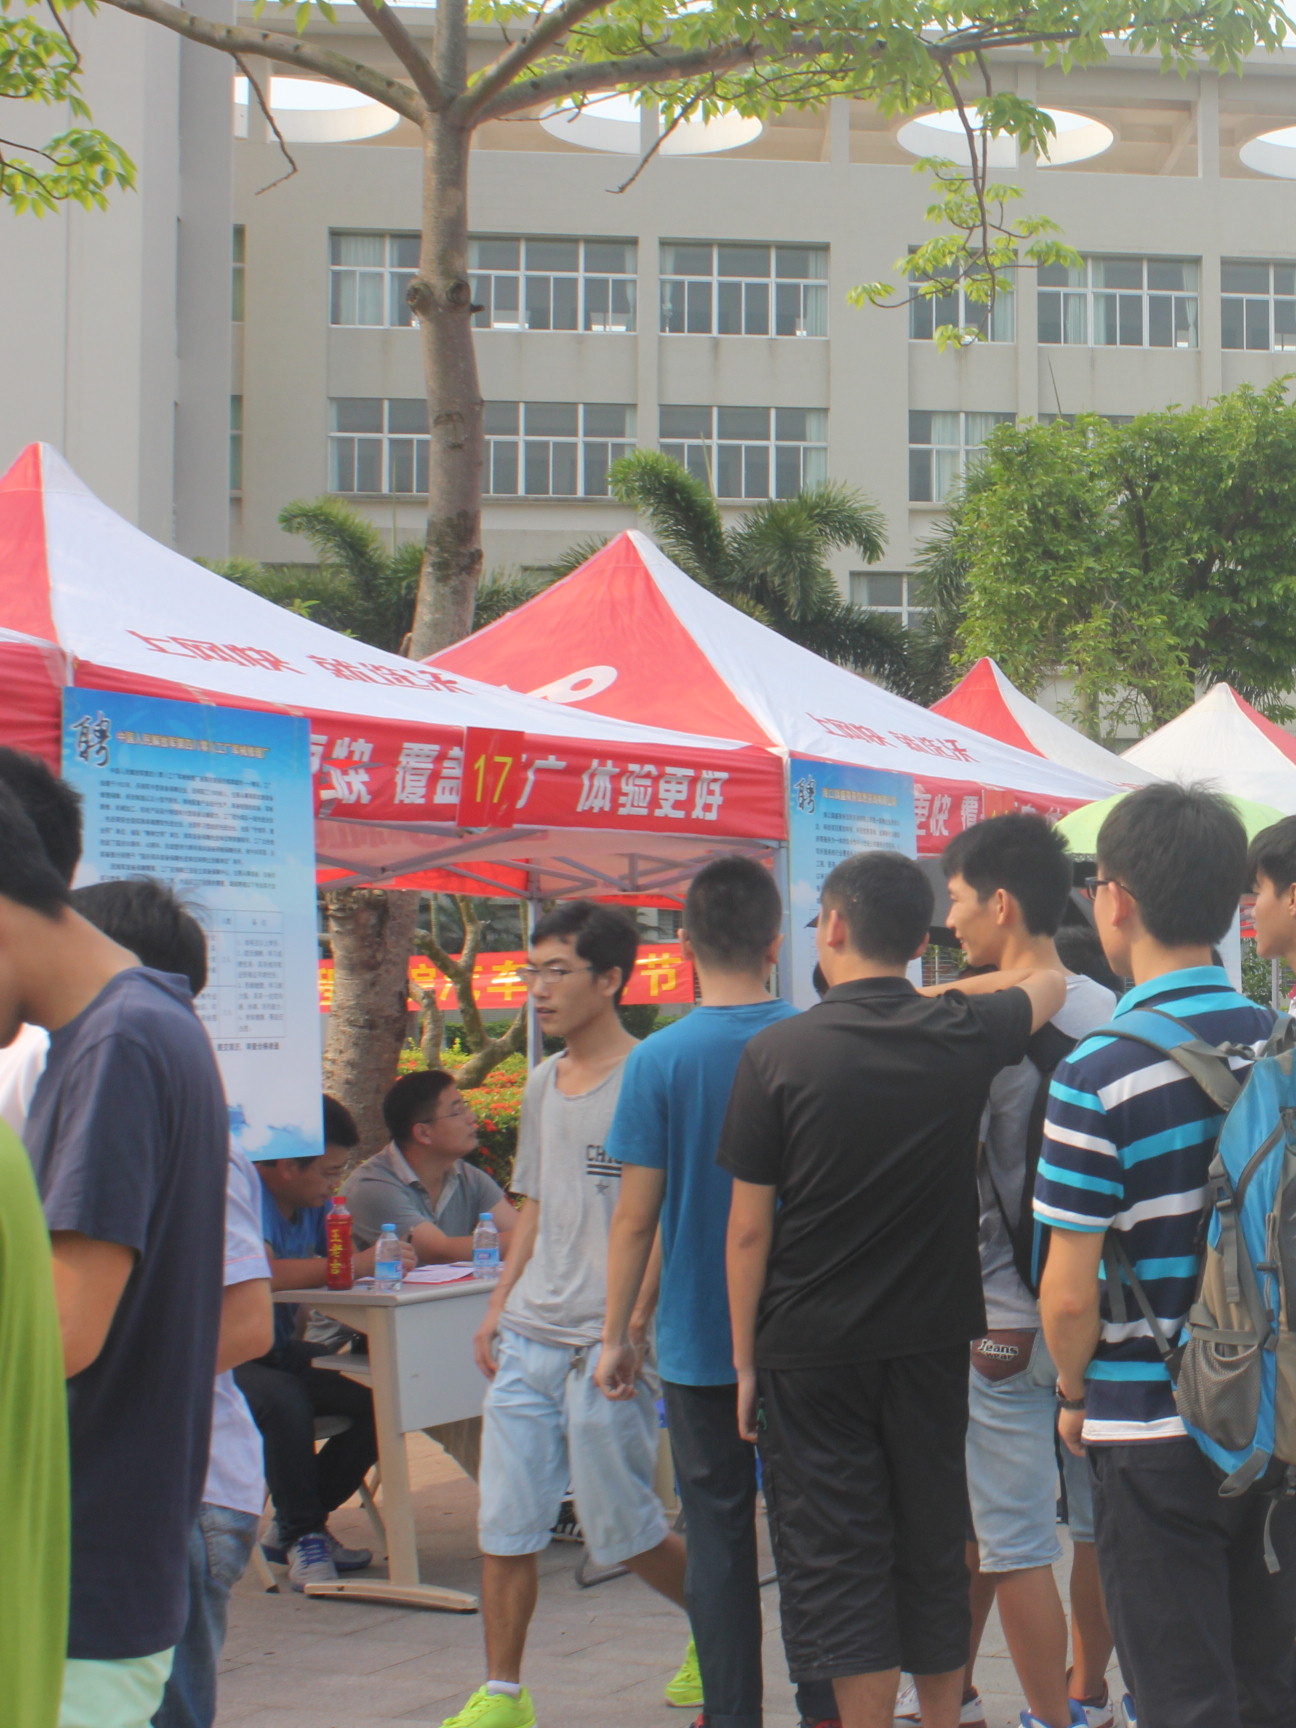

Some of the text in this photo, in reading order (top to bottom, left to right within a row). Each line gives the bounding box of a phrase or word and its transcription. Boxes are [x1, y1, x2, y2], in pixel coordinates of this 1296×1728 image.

[126, 629, 305, 675] 上网快
[474, 754, 513, 803] 17
[576, 758, 730, 820] 体验更好
[329, 1228, 344, 1275] 王老吉
[977, 1338, 1019, 1356] Jeans
